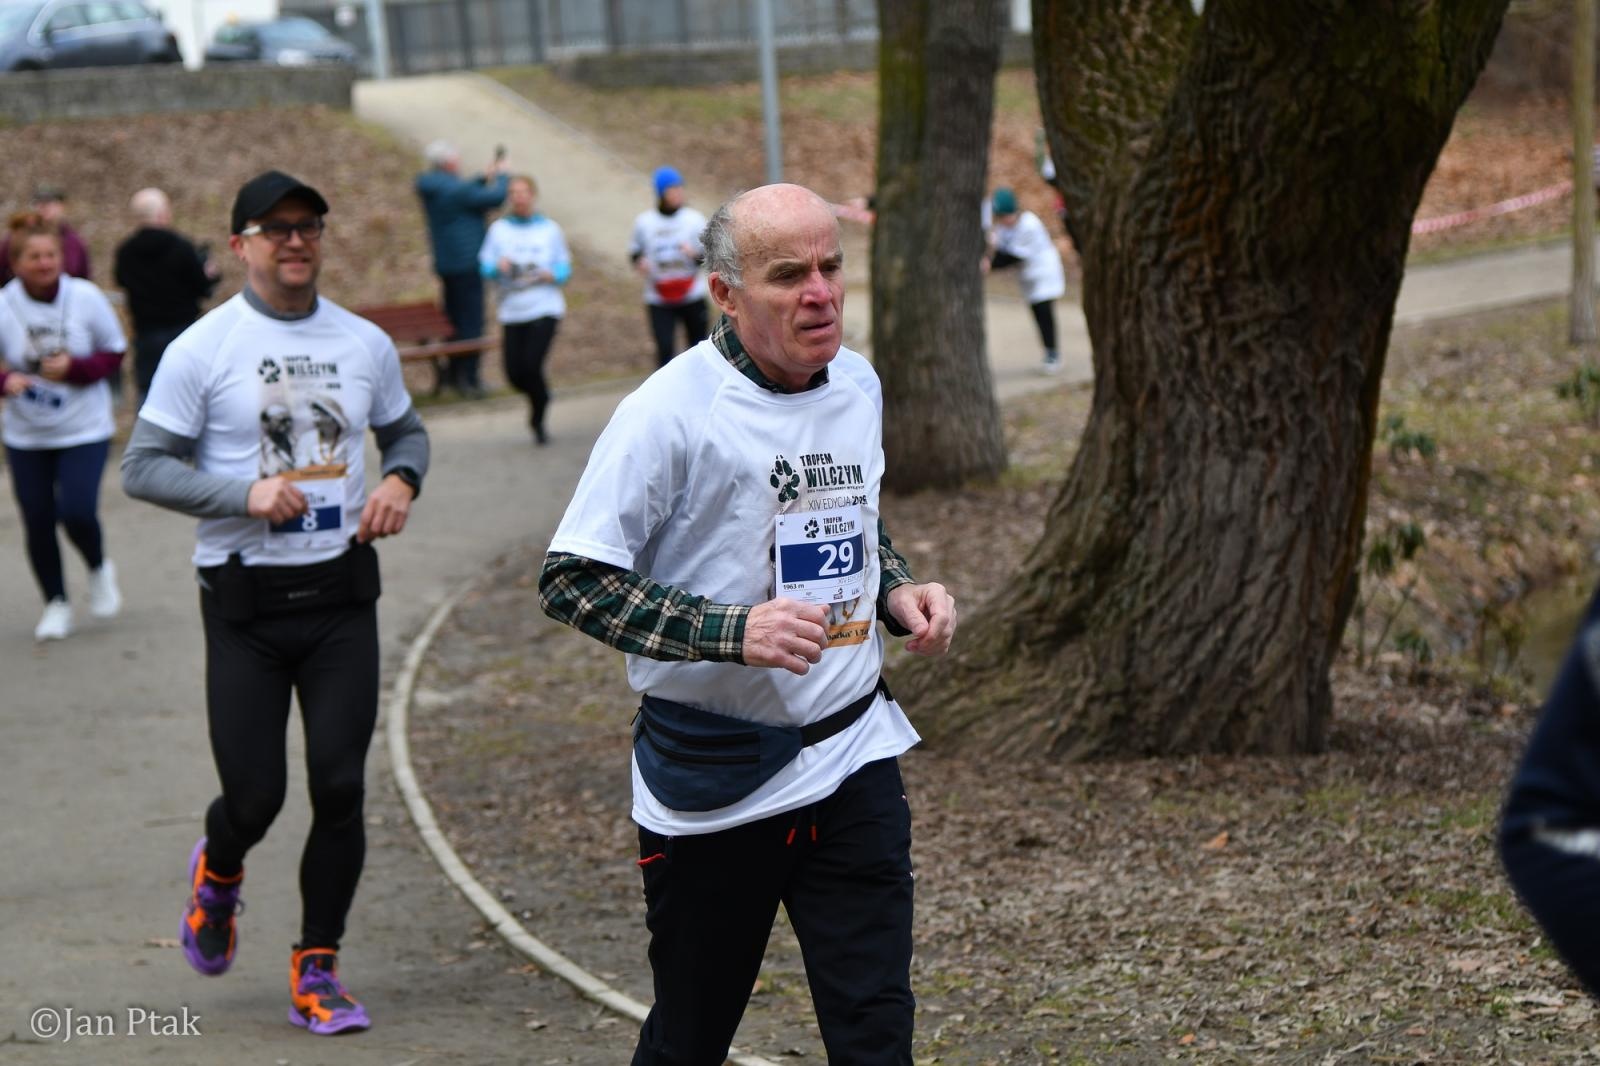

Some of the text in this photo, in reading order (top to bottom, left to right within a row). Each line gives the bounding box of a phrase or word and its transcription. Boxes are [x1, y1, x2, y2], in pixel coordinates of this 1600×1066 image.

[800, 453, 834, 467] TROPEM
[804, 464, 864, 488] WILCZYM
[808, 499, 821, 511] XIV
[823, 496, 851, 510] EDYCJA
[302, 510, 318, 532] 8
[823, 516, 842, 525] TROPEM
[824, 520, 855, 535] WILCZYM
[817, 540, 854, 577] 29
